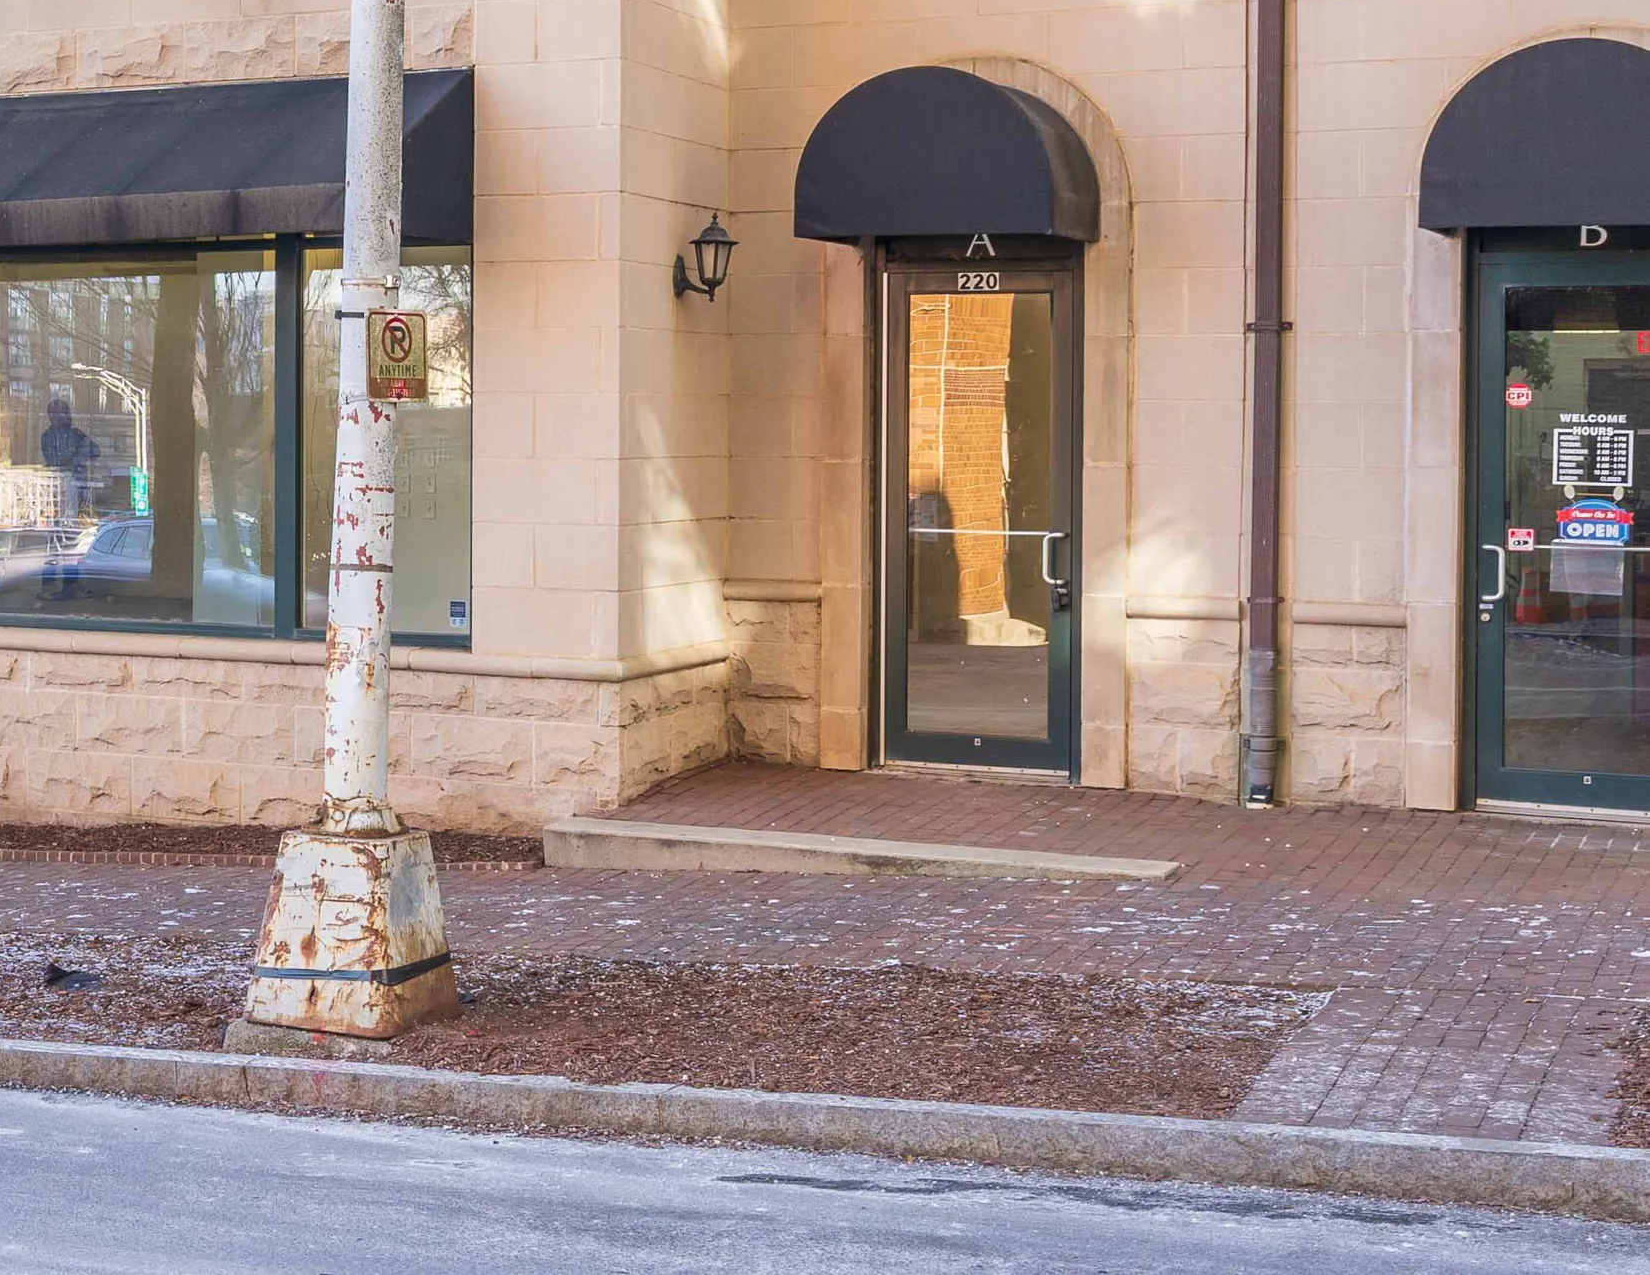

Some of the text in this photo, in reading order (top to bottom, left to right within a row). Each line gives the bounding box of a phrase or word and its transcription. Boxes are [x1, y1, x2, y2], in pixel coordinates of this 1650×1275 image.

[966, 234, 996, 257] A
[959, 273, 998, 290] 220
[378, 365, 417, 376] ANYTIME
[1559, 413, 1627, 423] WELCOME
[1572, 426, 1614, 436] HOURS
[1567, 522, 1619, 537] OPEN
